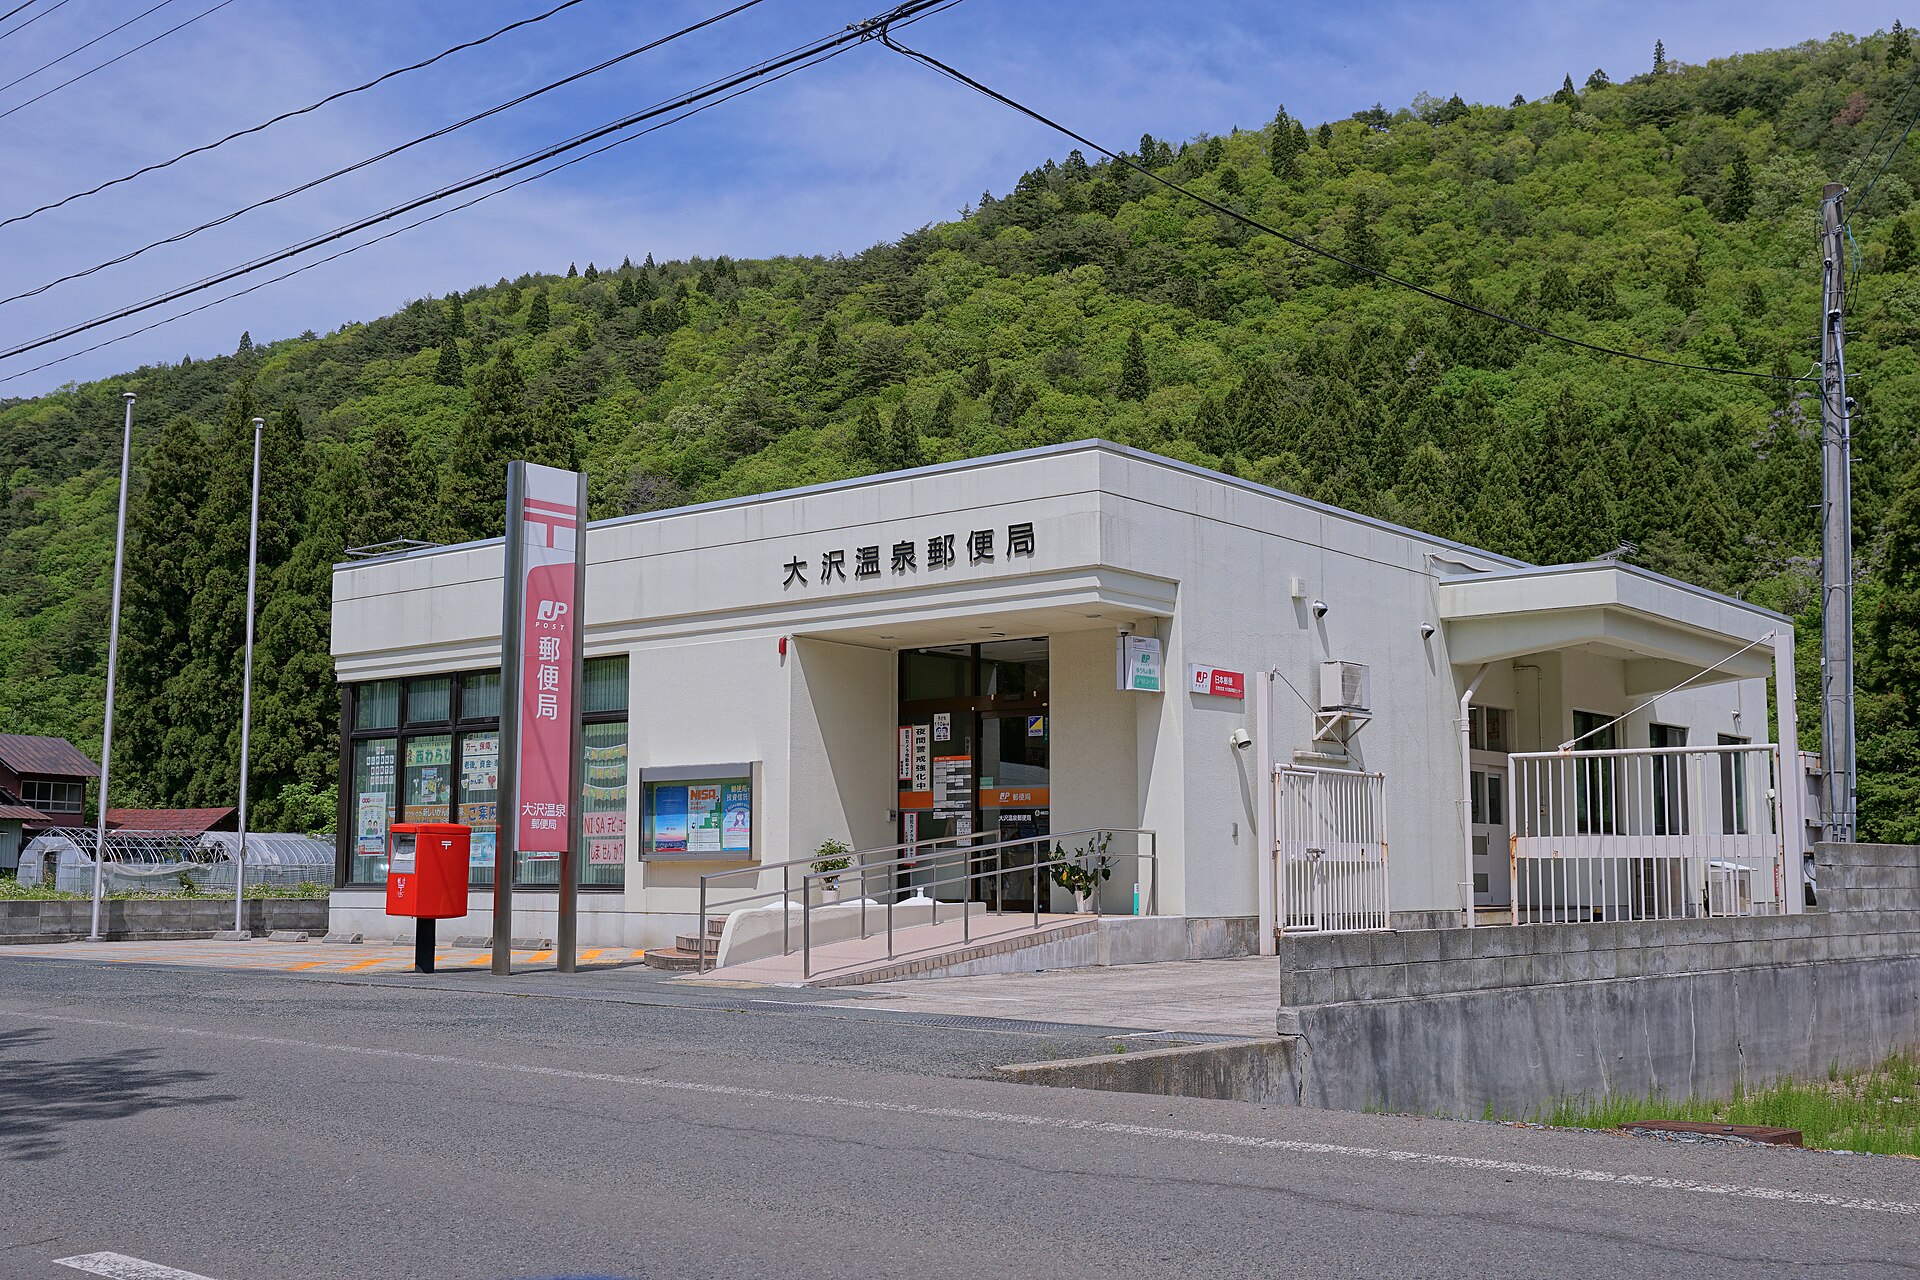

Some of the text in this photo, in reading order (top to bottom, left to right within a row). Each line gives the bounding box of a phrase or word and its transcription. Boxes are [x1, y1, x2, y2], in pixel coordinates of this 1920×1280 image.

[783, 522, 1035, 586] 大沢温泉郵便局
[535, 622, 565, 631] POST
[536, 636, 561, 721] 郵便局
[1214, 675, 1234, 686] 日本郵便
[915, 728, 927, 790] 夜間警戒強化中
[690, 789, 716, 801] NISA
[1012, 793, 1031, 801] 郵便局
[522, 802, 566, 817] 大沢温泉
[531, 818, 557, 830] 郵便局
[999, 814, 1031, 822] 大沢温泉郵便局
